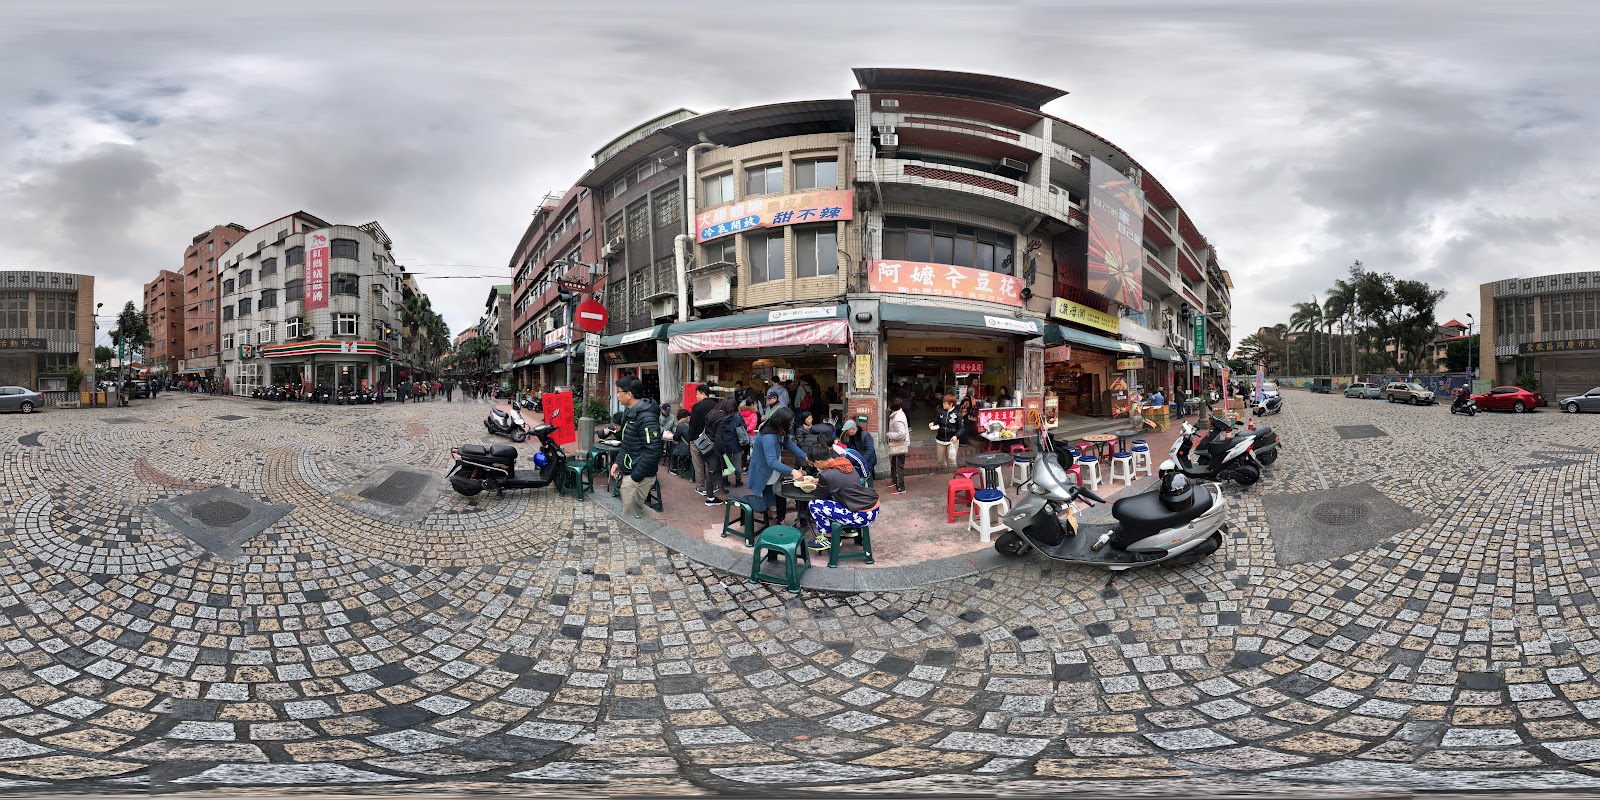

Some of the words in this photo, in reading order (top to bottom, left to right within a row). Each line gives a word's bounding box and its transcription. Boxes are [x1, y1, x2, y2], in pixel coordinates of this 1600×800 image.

[698, 200, 763, 228] 大腸麵線
[772, 206, 842, 224] 甜不辣
[704, 216, 756, 237] 冷氣開放
